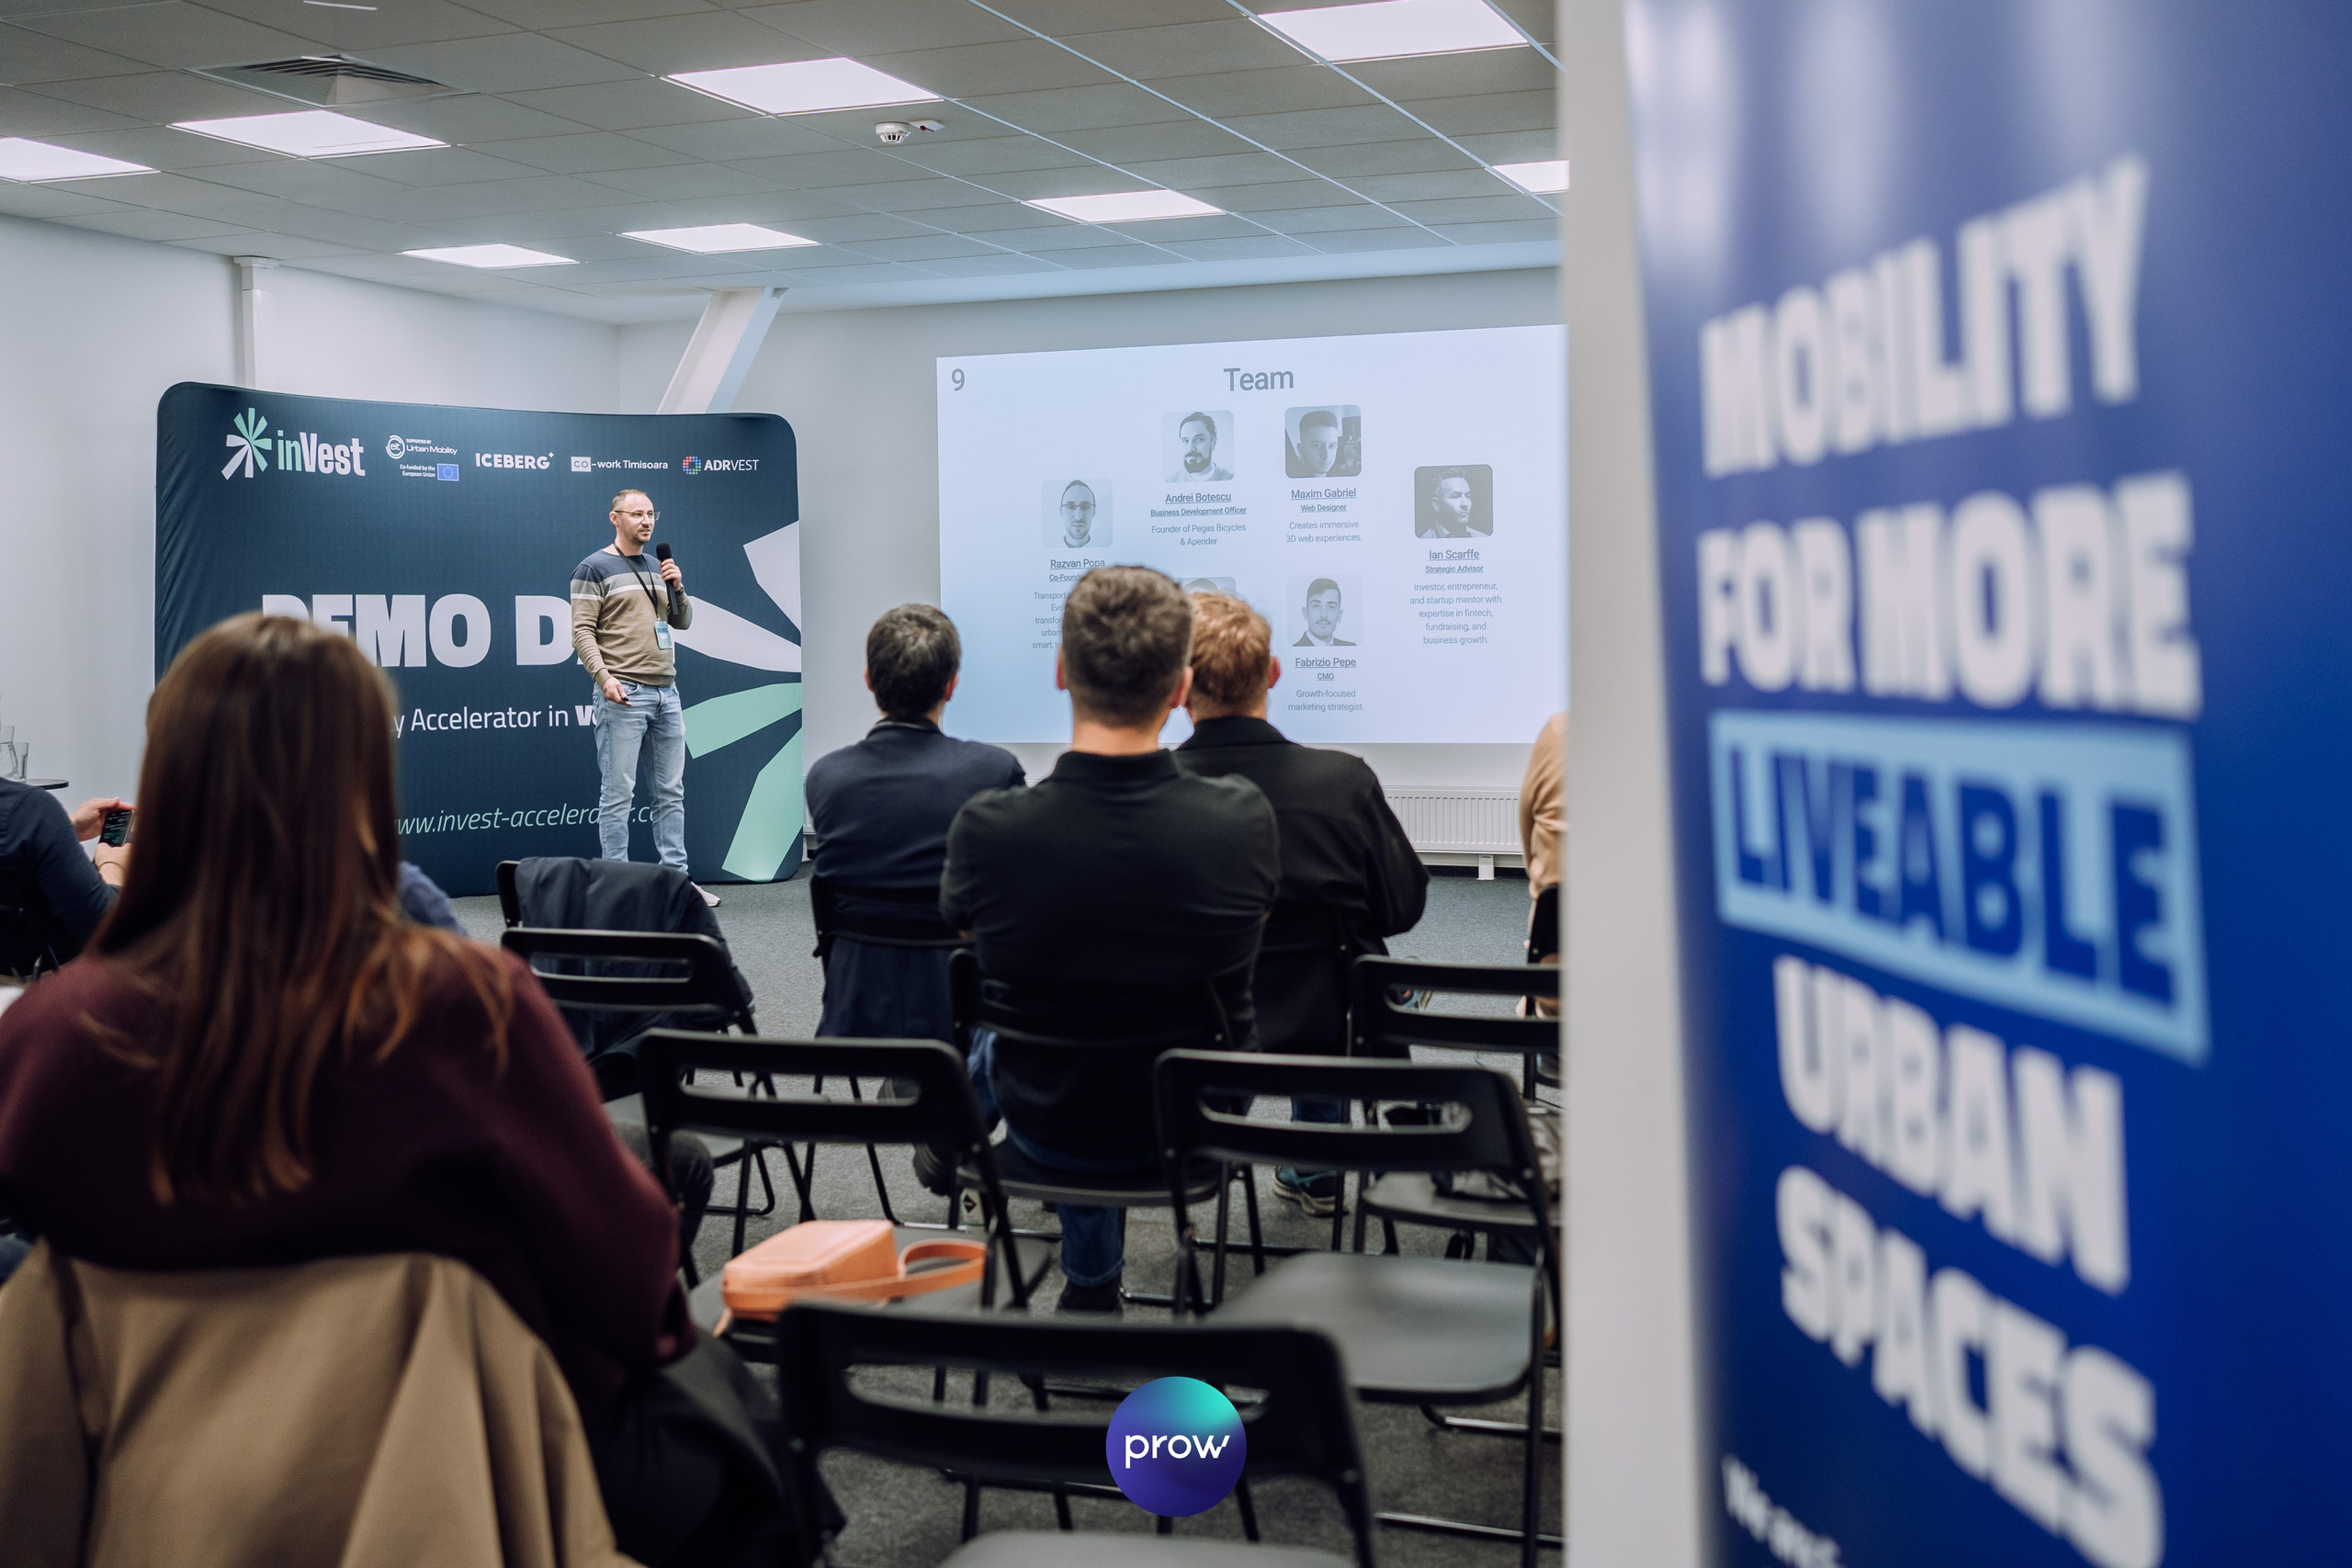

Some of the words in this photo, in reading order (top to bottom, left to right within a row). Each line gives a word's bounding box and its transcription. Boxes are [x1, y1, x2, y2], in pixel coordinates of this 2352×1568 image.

[1700, 152, 2151, 479] MOBILITY
[951, 368, 966, 391] 9
[1223, 367, 1295, 391] Team
[277, 430, 366, 476] inVest
[429, 446, 458, 455] Mobility
[623, 460, 669, 470] Timisoara
[704, 459, 759, 471] ADRVEST
[1165, 493, 1193, 502] Andrei
[1195, 492, 1232, 502] Botescu
[1291, 490, 1322, 499] Maxim
[1324, 488, 1356, 498] Gabriel
[1150, 508, 1180, 516] Business
[1181, 507, 1223, 516] Development
[1225, 506, 1247, 514] Officer
[1317, 504, 1347, 513] Designer
[1151, 525, 1181, 534] Founder
[1182, 525, 1191, 533] of
[1192, 525, 1215, 535] Pegas
[1216, 524, 1246, 534] Bicycles
[1289, 522, 1317, 530] Creates
[1319, 520, 1359, 529] immersive
[1187, 537, 1217, 547] Aperider
[1286, 535, 1296, 543] 3D
[1297, 535, 1314, 543] web
[1316, 534, 1363, 544] experiences.
[1429, 550, 1443, 559] Ian
[1445, 548, 1480, 559] Scarffe
[1050, 559, 1081, 568] Razvan
[1083, 558, 1105, 568] Popa
[1425, 566, 1456, 574] Strategic
[1414, 583, 1446, 592] Investor,
[1447, 582, 1498, 592] entrepreneur,
[1696, 518, 1855, 694] FOR
[1855, 468, 2203, 721] MORE
[1410, 596, 1425, 604] and
[1426, 597, 1454, 605] startup
[1485, 595, 1502, 604] with
[1419, 610, 1454, 619] expertise
[1455, 609, 1463, 617] in
[1464, 608, 1494, 617] fintech,
[1425, 623, 1470, 632] fundraising,
[1472, 622, 1487, 630] and
[1459, 636, 1489, 645] growth.
[1295, 658, 1331, 667] Fabrizio
[1333, 658, 1356, 668] Pepe
[1296, 690, 1356, 698] Growth-focused
[1288, 703, 1326, 712] marketing
[1327, 703, 1364, 712] strategist.
[411, 706, 542, 731] Accelerator
[548, 705, 569, 727] in
[1730, 742, 2177, 1011] LIVEABLE
[1772, 953, 2132, 1298] URBAN
[1775, 1165, 2166, 1568] SPACES
